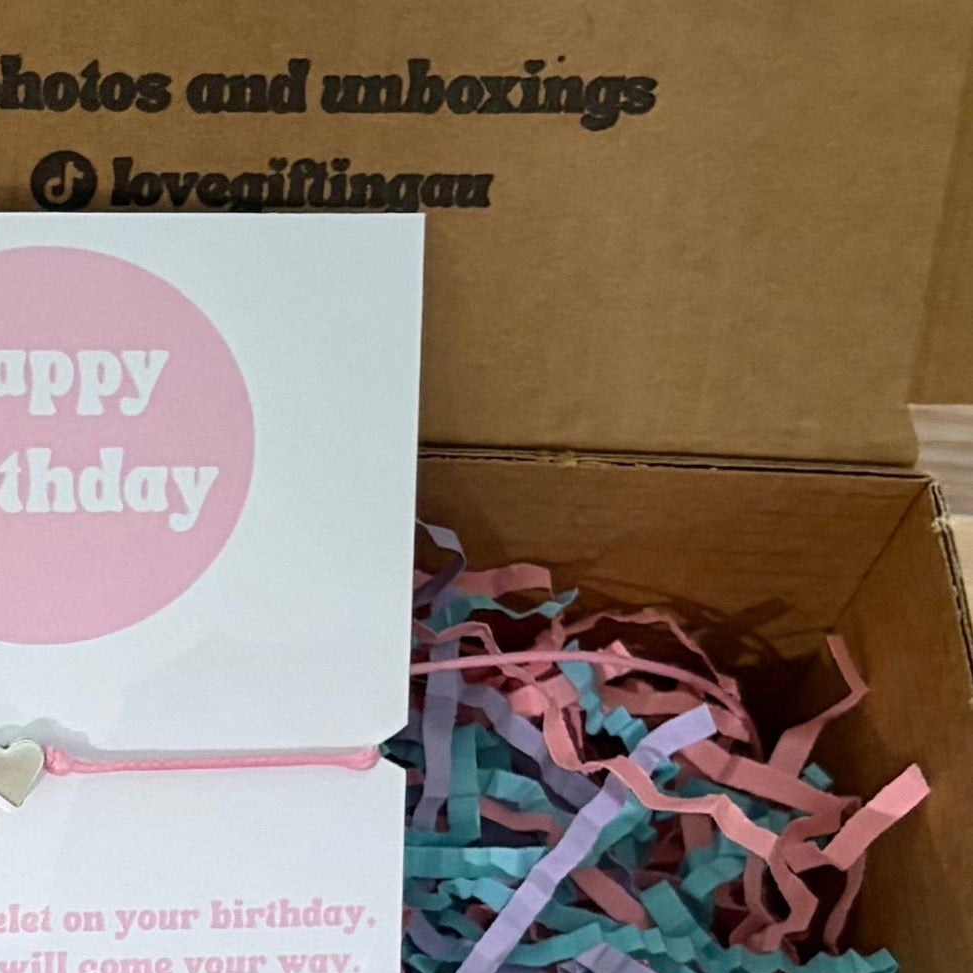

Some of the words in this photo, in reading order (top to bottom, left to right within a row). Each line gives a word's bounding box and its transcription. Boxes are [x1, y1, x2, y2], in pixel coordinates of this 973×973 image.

[186, 58, 311, 114] and
[321, 56, 657, 131] unboxings
[61, 911, 106, 934] on
[115, 907, 202, 940] your
